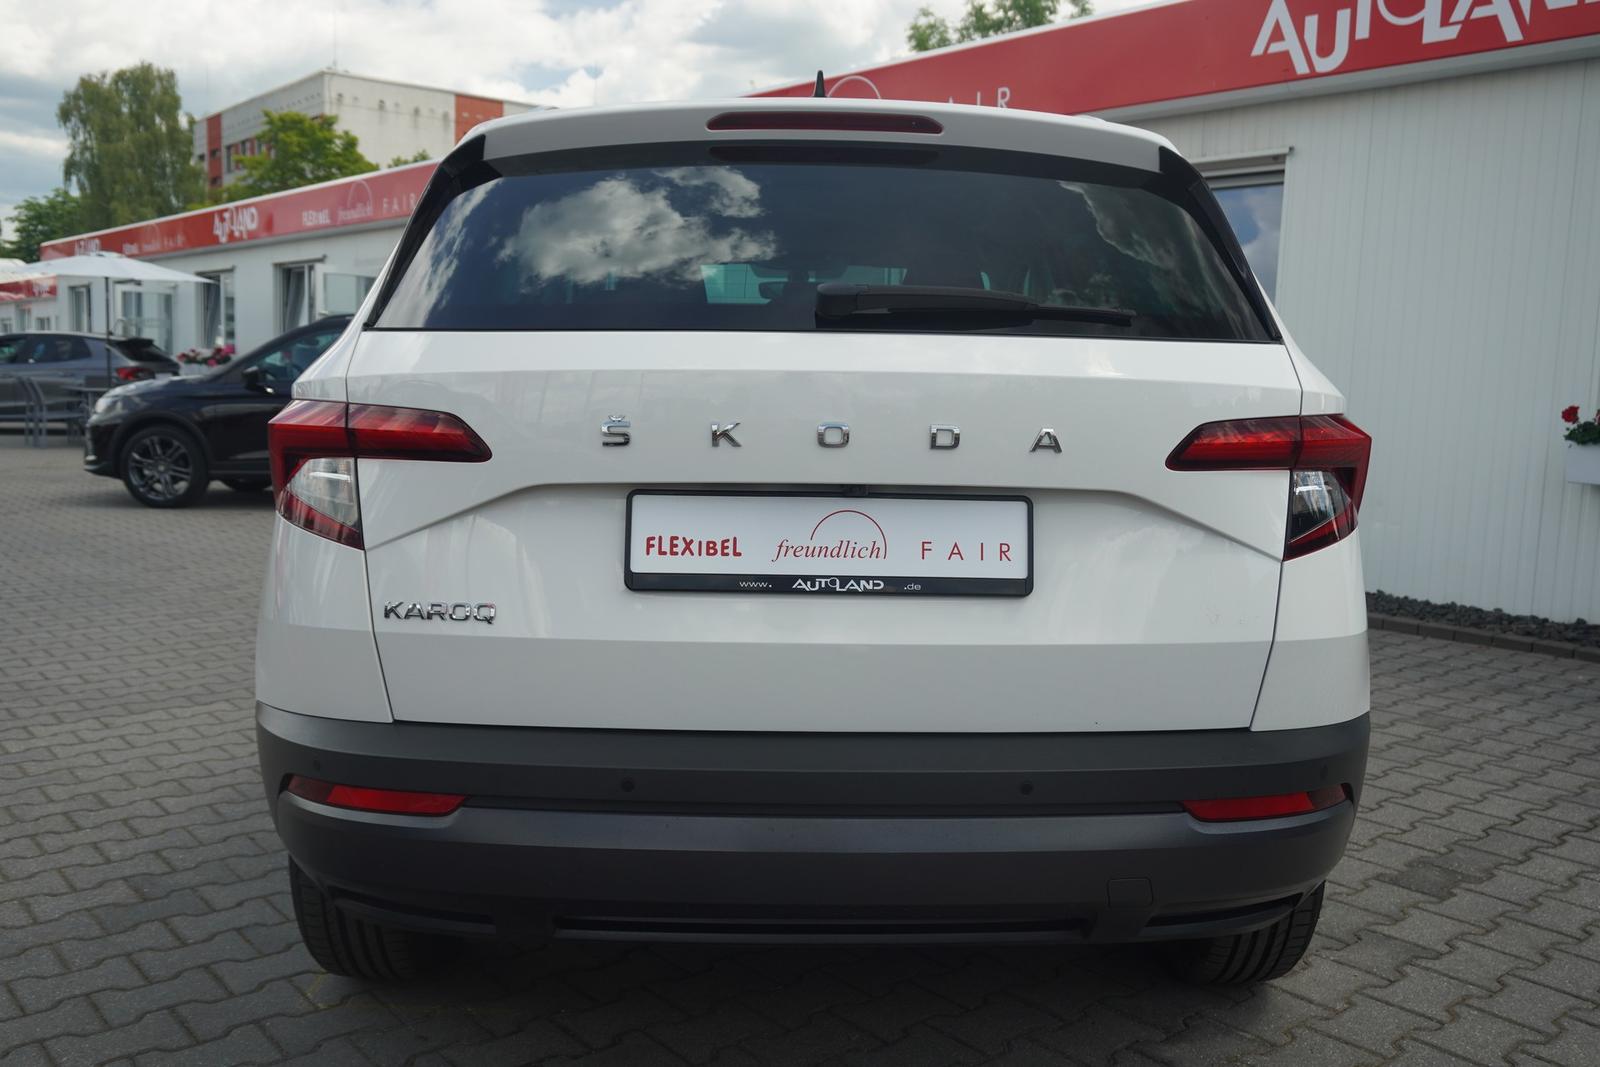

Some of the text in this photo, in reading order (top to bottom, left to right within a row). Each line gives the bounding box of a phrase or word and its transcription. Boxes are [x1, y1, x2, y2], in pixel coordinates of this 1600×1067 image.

[601, 414, 1063, 454] ŠKODA
[645, 535, 1012, 562] FLEXIBEL freundlich FAIR
[739, 577, 922, 592] www. AUTOLAND .de
[383, 601, 496, 624] KAROQ
